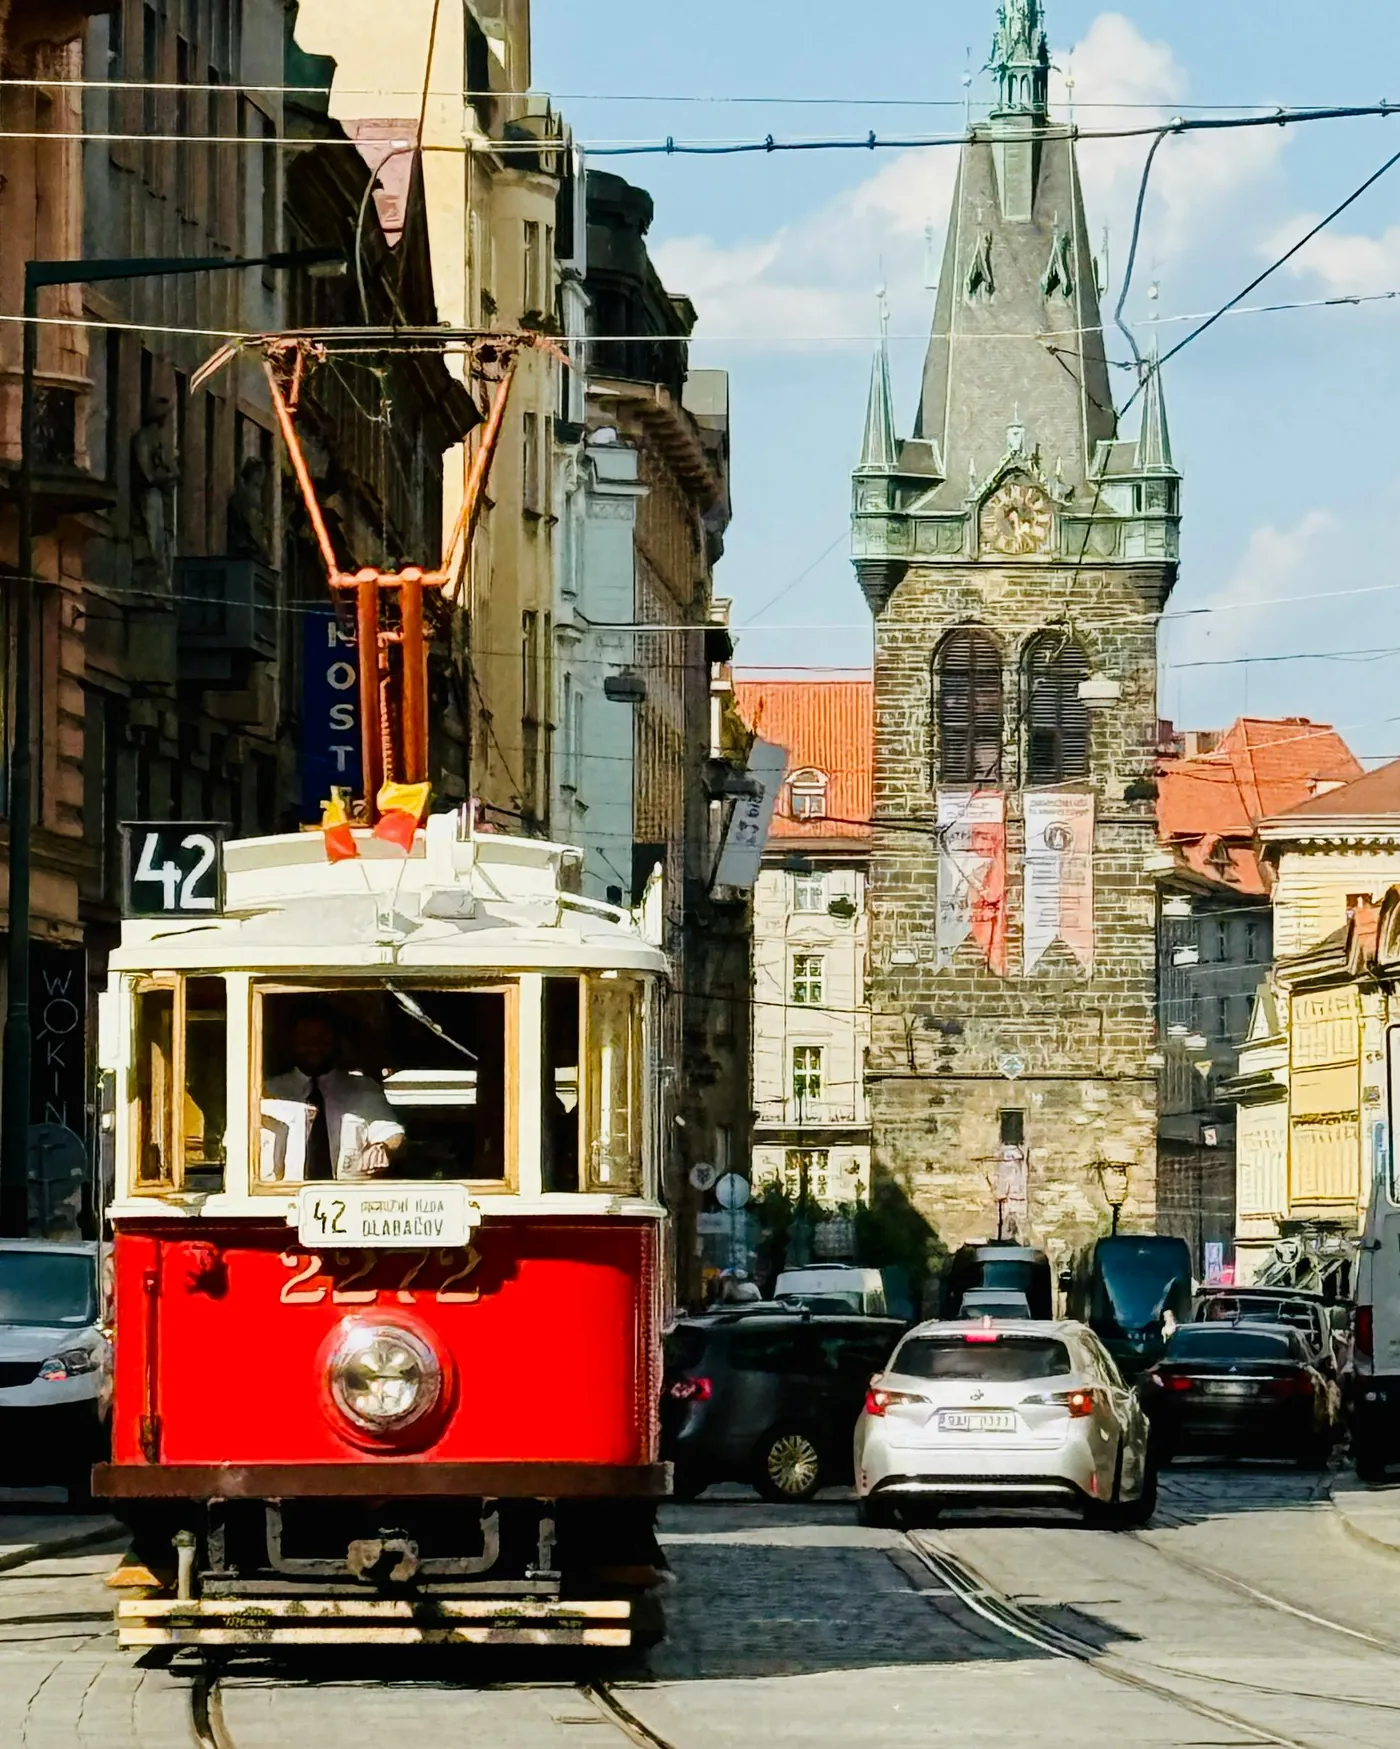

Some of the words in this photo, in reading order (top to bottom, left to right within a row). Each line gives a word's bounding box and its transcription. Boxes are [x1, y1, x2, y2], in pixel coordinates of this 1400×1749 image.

[134, 832, 216, 910] 42
[313, 1200, 347, 1234] 42
[278, 1245, 483, 1304] 2272
